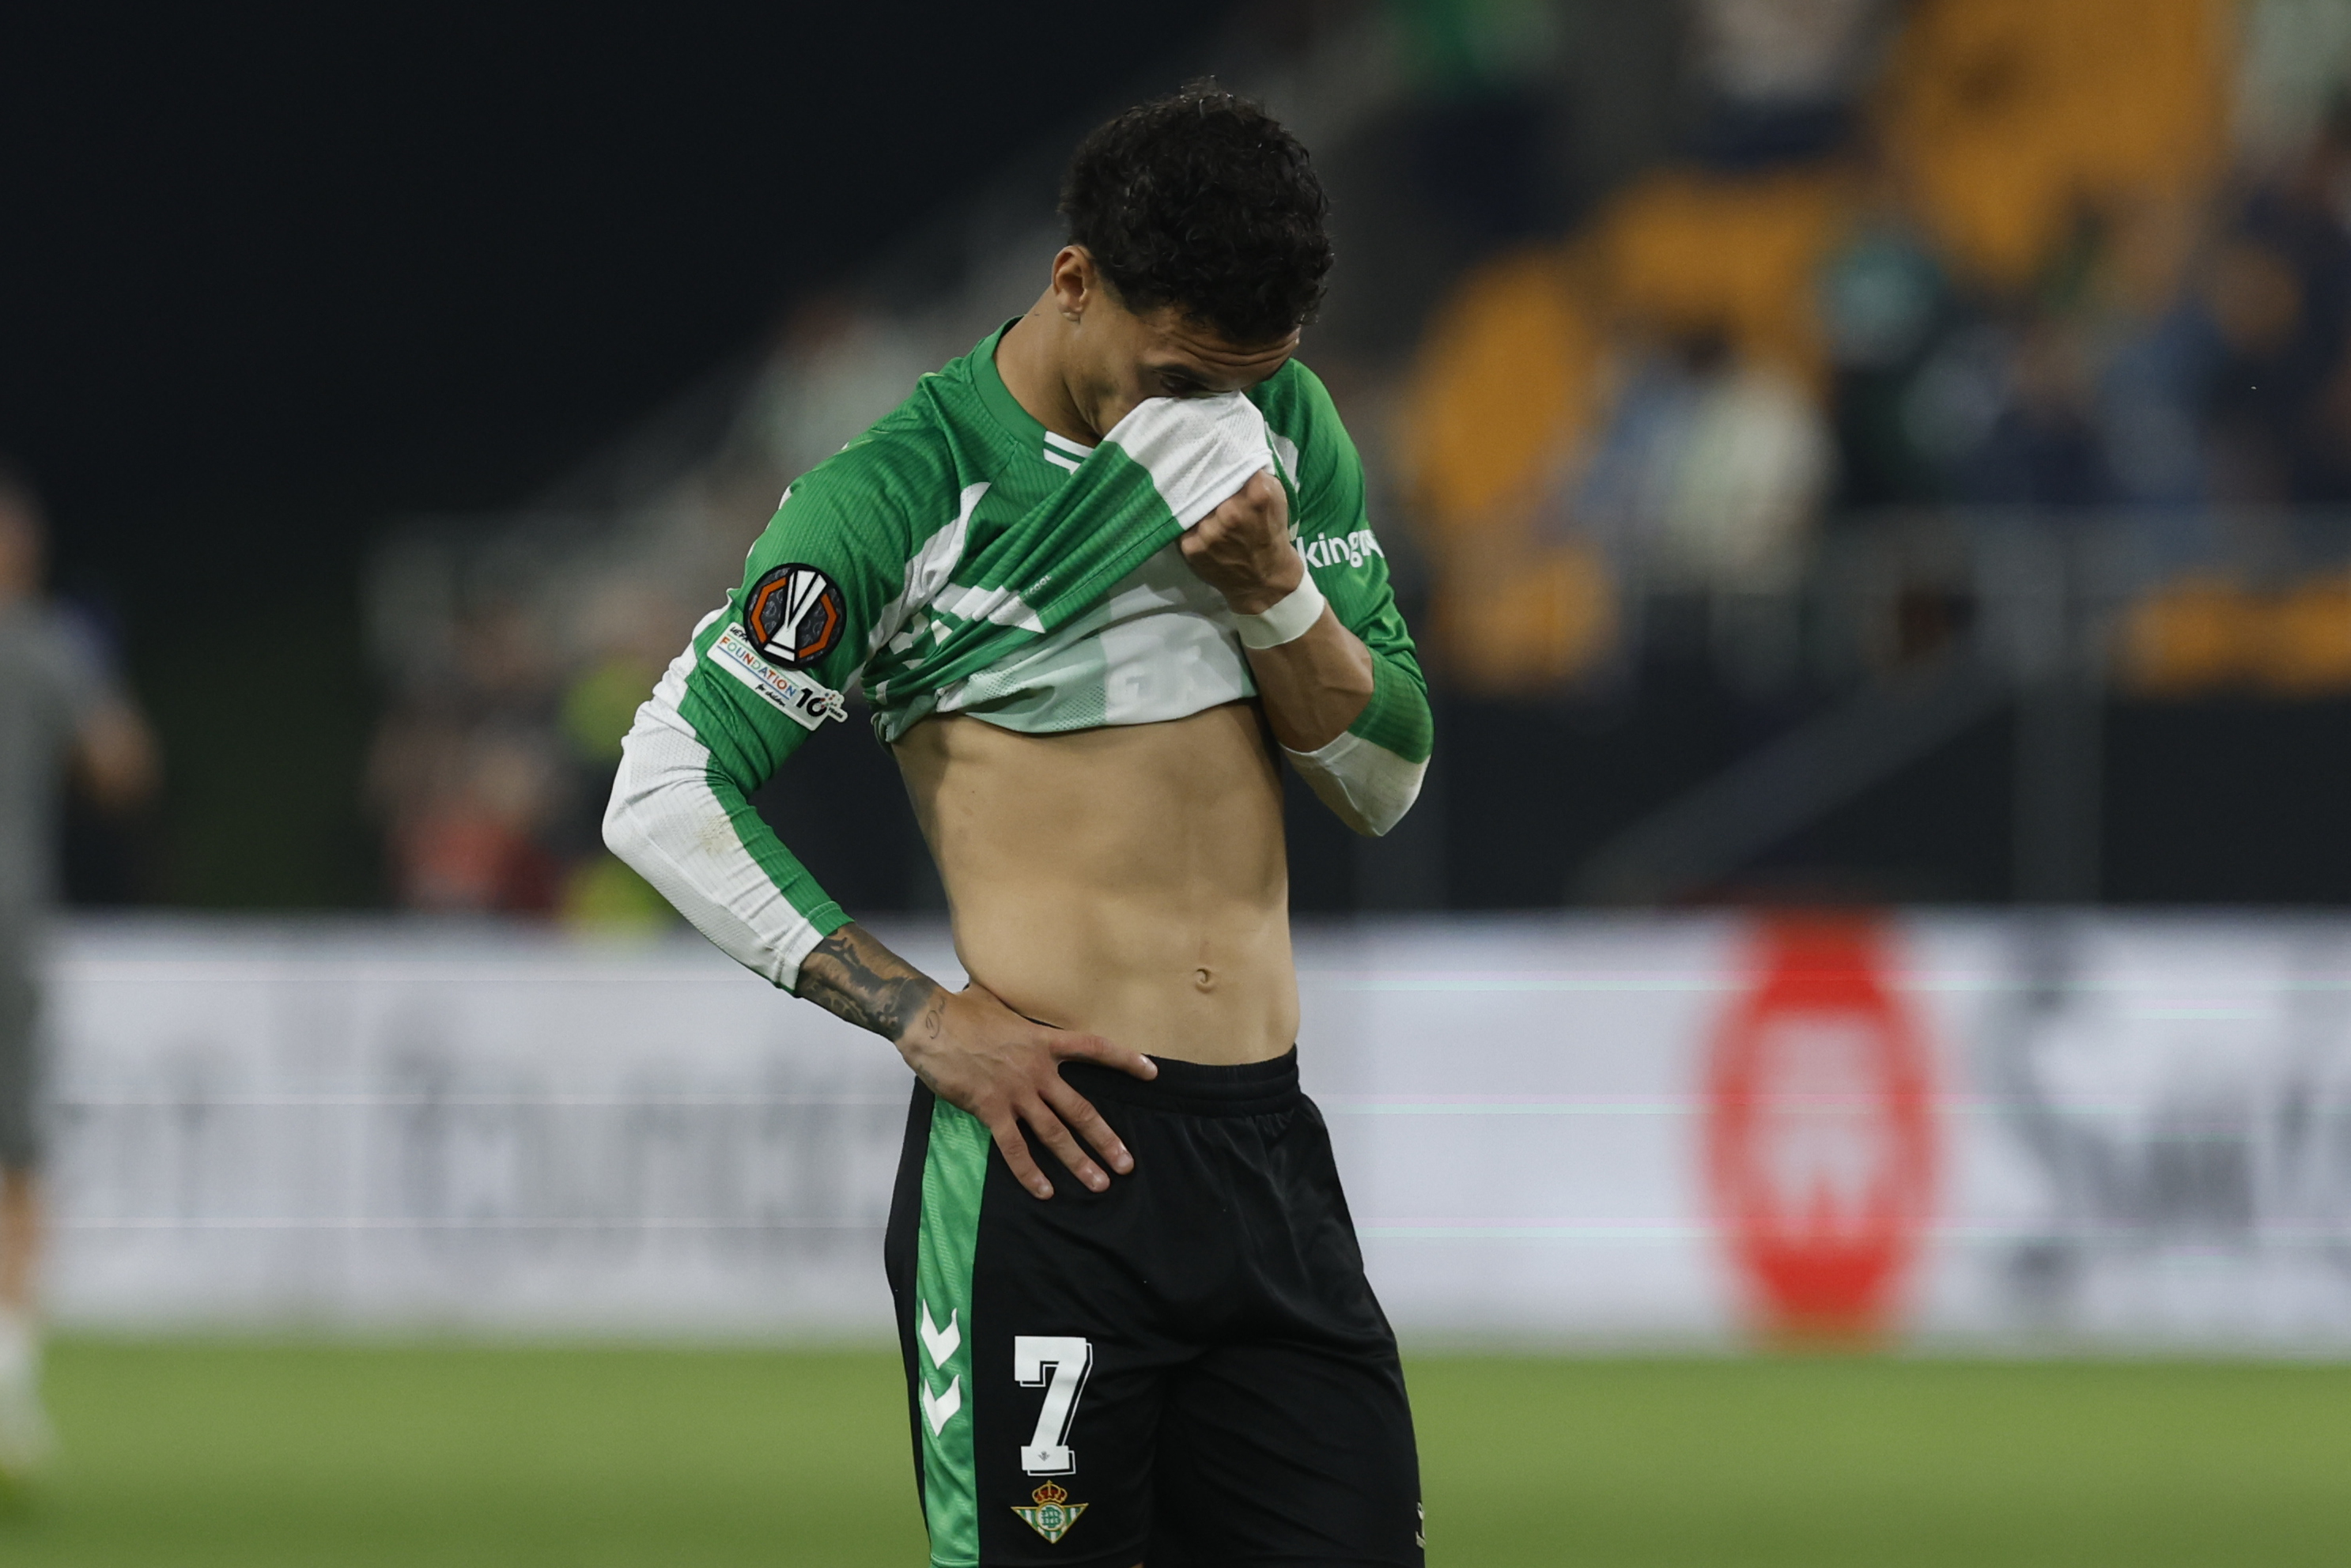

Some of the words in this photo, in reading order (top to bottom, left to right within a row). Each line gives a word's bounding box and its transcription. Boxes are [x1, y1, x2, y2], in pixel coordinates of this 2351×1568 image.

[730, 626, 748, 643] UEFA
[720, 636, 797, 697] FOUNDATION
[796, 687, 828, 717] 10
[1015, 1335, 1092, 1475] 7
